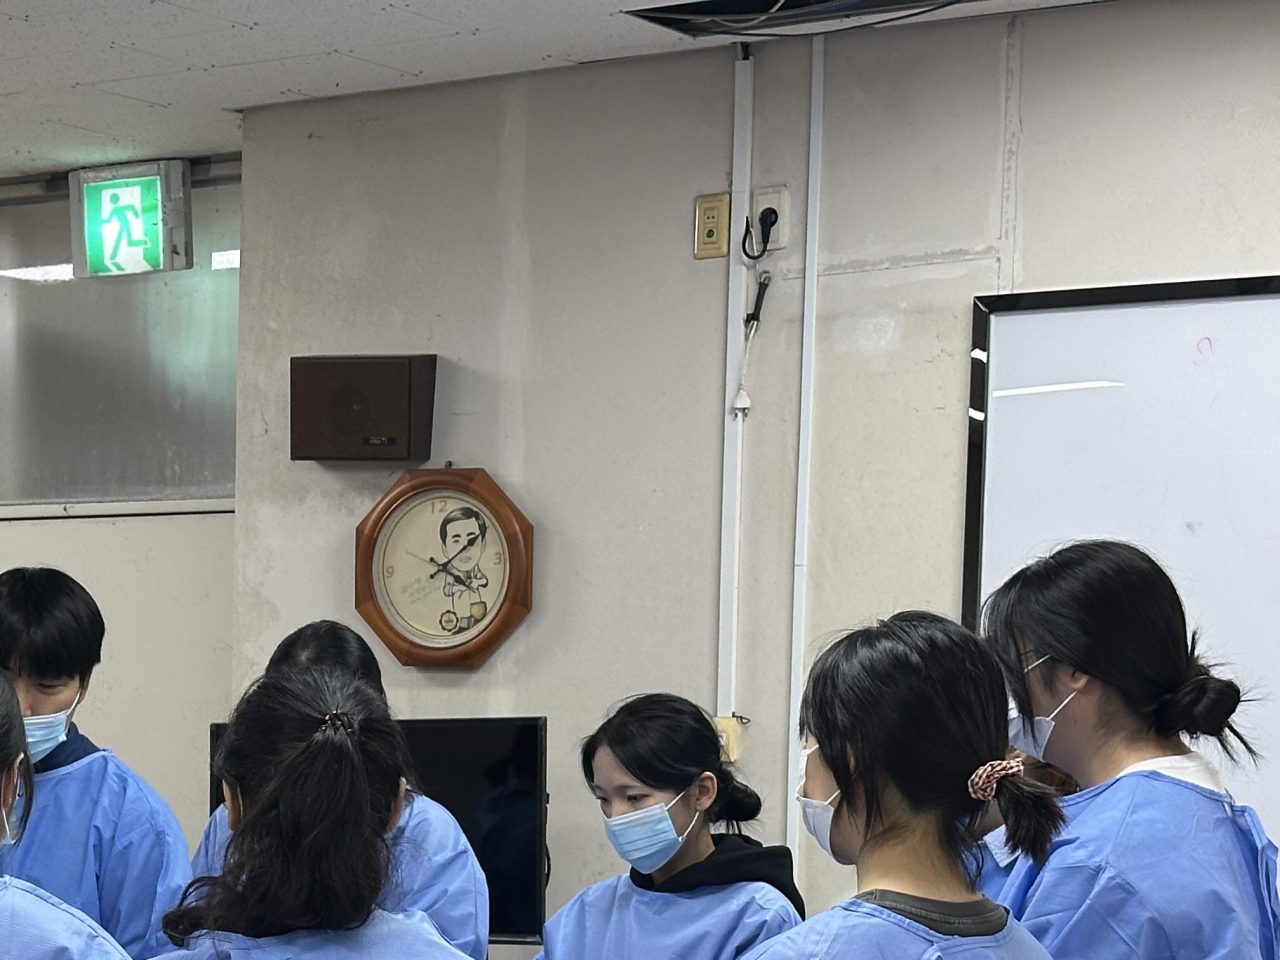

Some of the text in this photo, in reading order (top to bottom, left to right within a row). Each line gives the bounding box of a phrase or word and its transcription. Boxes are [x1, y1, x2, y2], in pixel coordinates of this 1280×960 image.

[429, 500, 447, 514] 12
[493, 552, 503, 566] 3
[385, 565, 395, 579] 9
